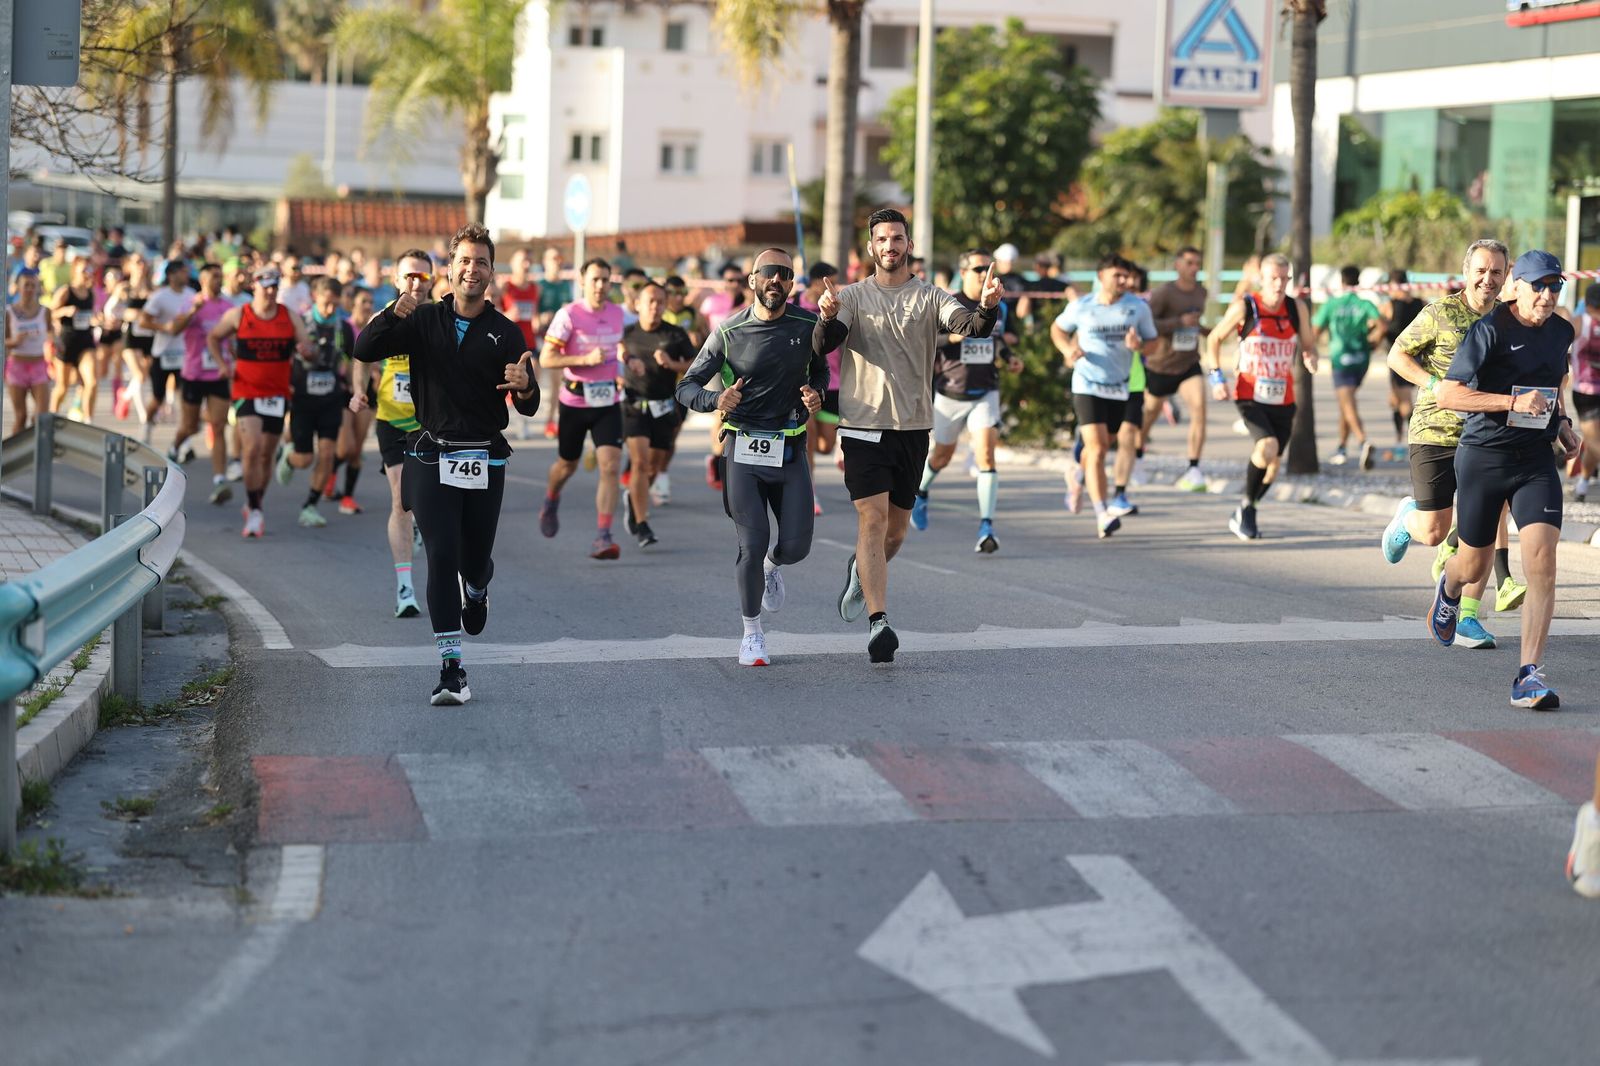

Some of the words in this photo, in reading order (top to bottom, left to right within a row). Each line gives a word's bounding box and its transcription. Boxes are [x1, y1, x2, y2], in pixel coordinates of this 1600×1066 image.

[1178, 68, 1255, 91] ALDI
[964, 344, 992, 355] 2016
[748, 439, 771, 454] 49
[447, 460, 481, 476] 746
